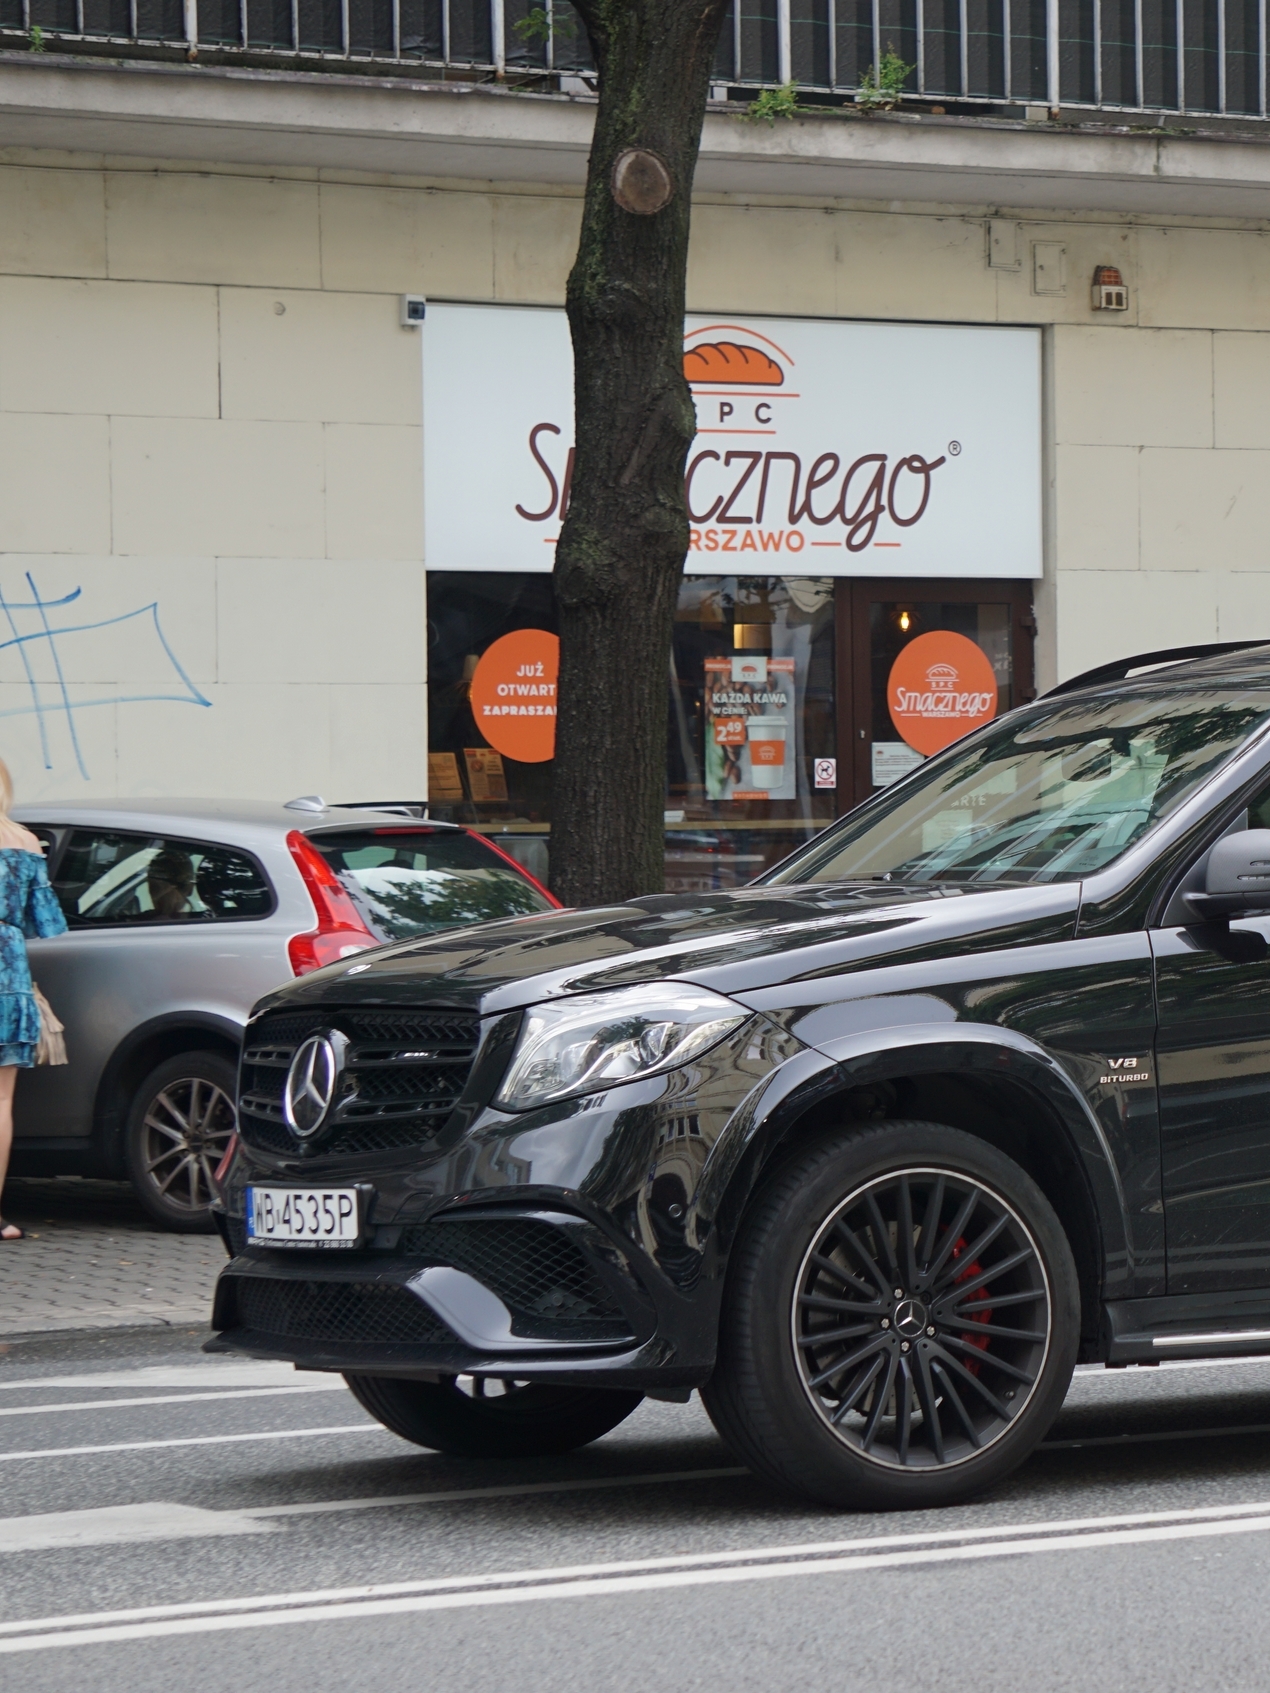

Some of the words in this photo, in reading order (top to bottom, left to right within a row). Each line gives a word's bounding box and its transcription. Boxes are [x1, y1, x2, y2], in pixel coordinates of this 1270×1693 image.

[719, 401, 773, 425] PC
[515, 422, 947, 553] Scznego
[689, 529, 805, 552] RSZAWO
[516, 661, 544, 677] JUŻ
[497, 684, 556, 696] OTWART
[712, 690, 751, 704] KAŻDA
[753, 693, 787, 704] KAWA
[894, 687, 994, 717] Smacznego
[483, 705, 557, 716] ZAPRASZA
[722, 707, 748, 715] CENIE:
[1107, 1057, 1138, 1070] V8
[1100, 1073, 1149, 1084] BITURBO
